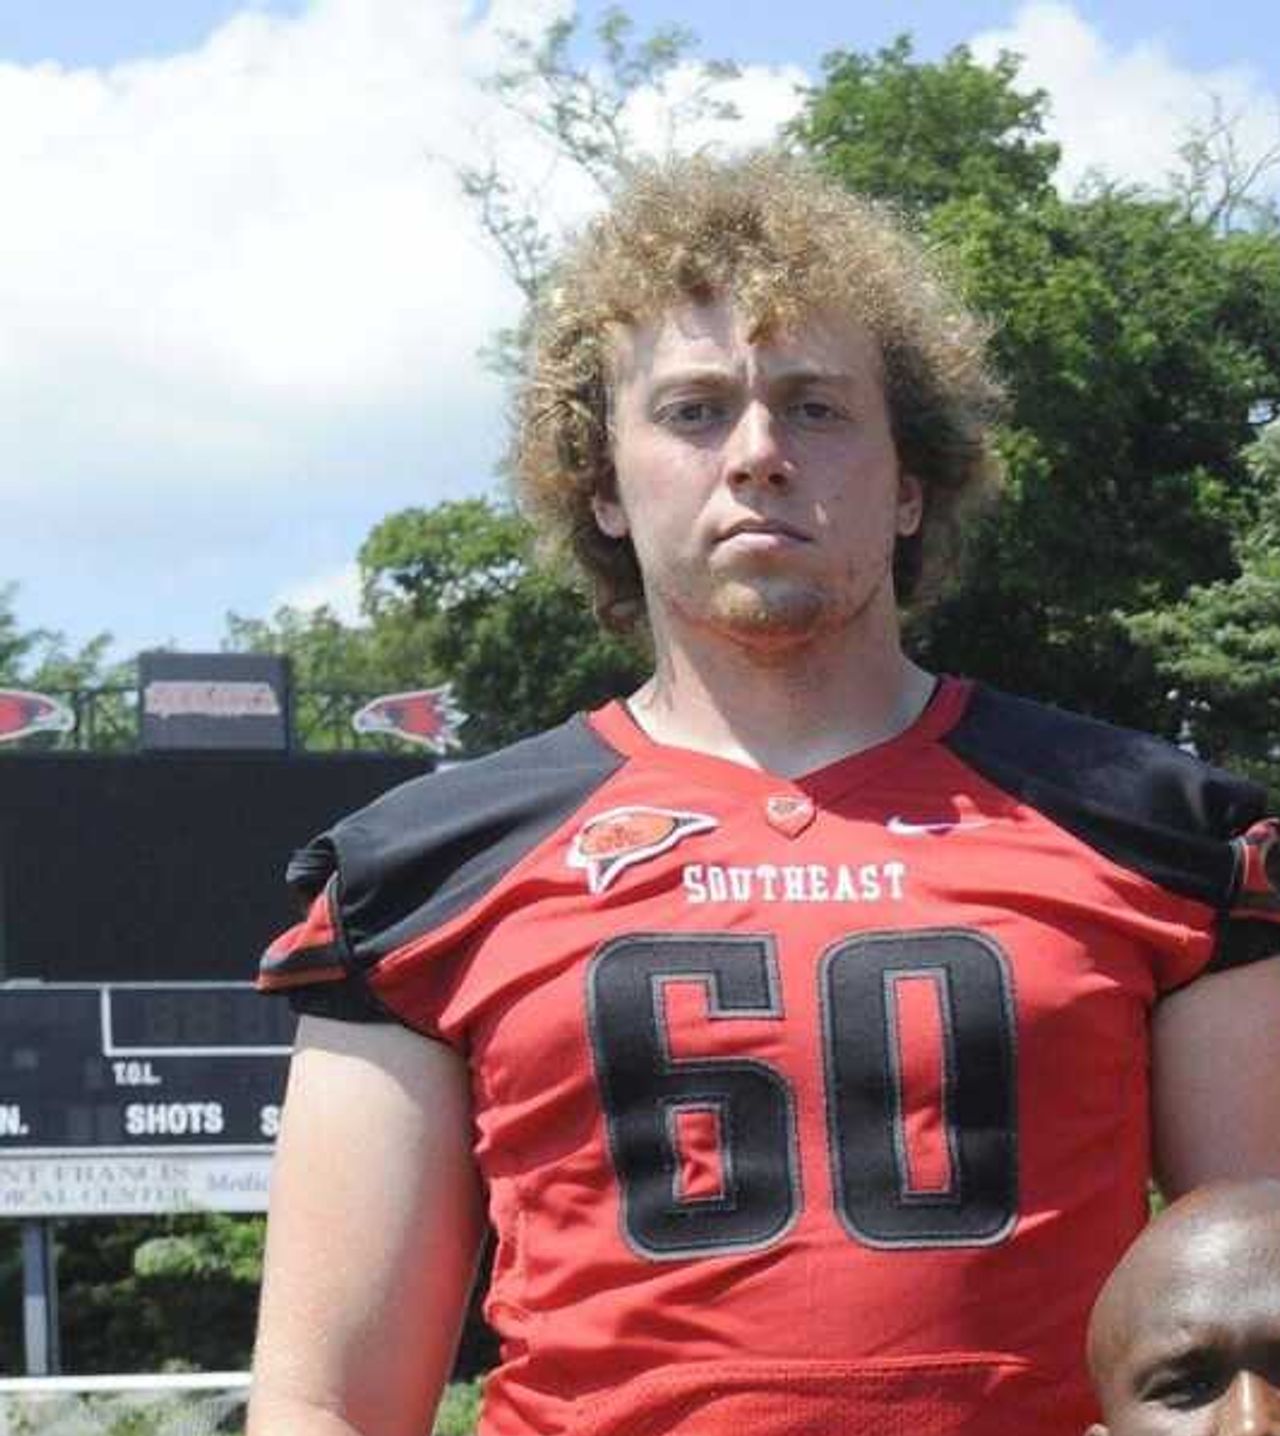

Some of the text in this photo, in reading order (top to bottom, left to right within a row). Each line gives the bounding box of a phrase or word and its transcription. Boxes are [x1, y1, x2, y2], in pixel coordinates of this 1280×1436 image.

[682, 863, 906, 902] SOUTHEAST
[587, 928, 1019, 1262] 60
[126, 1103, 223, 1134] SHOTS
